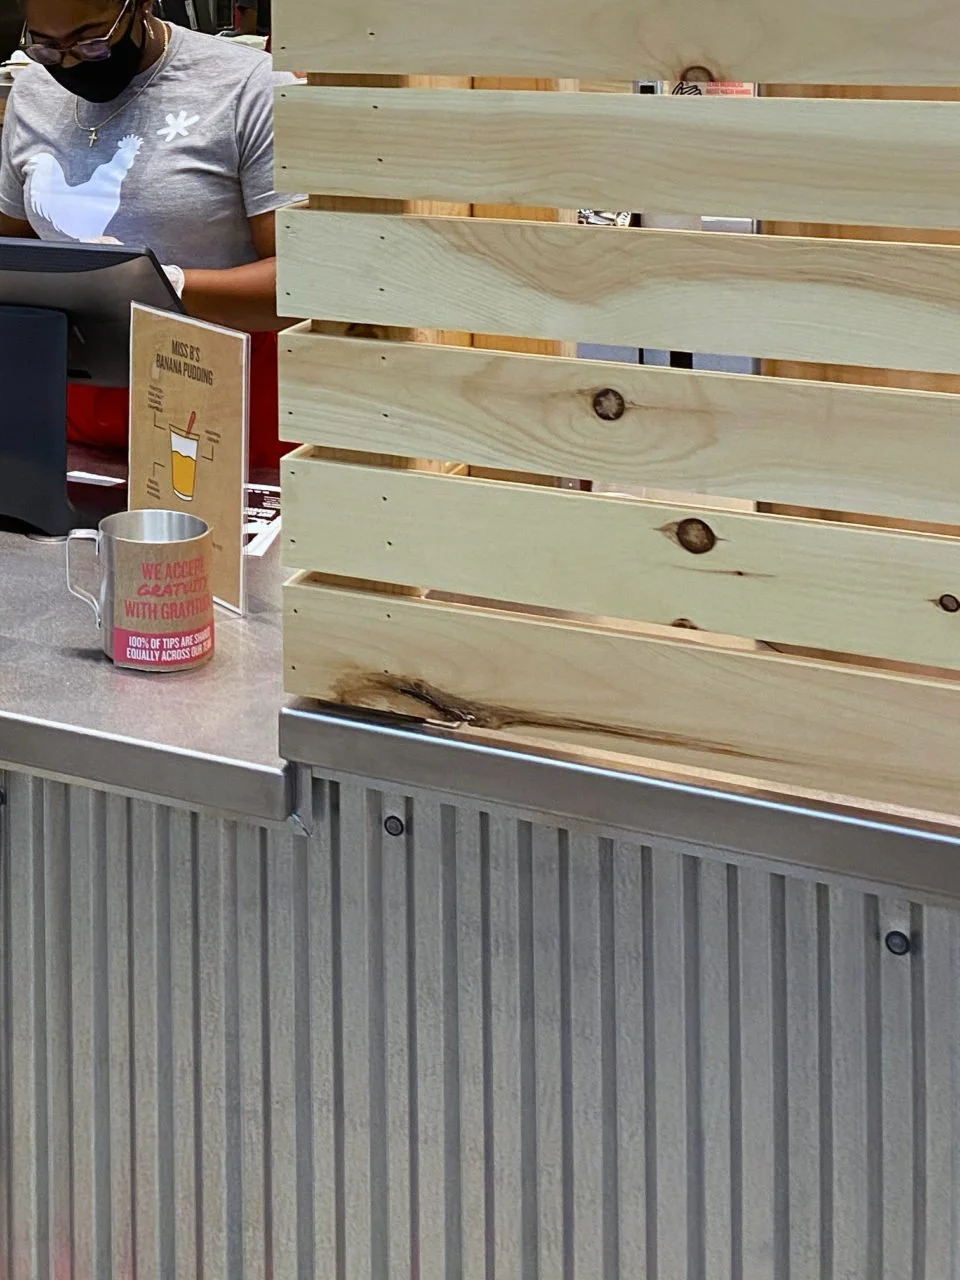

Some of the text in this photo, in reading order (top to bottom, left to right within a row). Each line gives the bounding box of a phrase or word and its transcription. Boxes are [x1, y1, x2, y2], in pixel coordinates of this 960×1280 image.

[172, 339, 201, 363] MISS B'S
[157, 353, 214, 386] BANANA PUDDING
[142, 562, 162, 580] WE
[125, 599, 157, 620] WITH
[129, 636, 149, 648] 100%
[151, 637, 161, 648] OF
[163, 636, 180, 649] TIPS
[181, 634, 194, 647] ARE
[127, 648, 160, 661] EQUALLY
[162, 648, 191, 661] ACROSS
